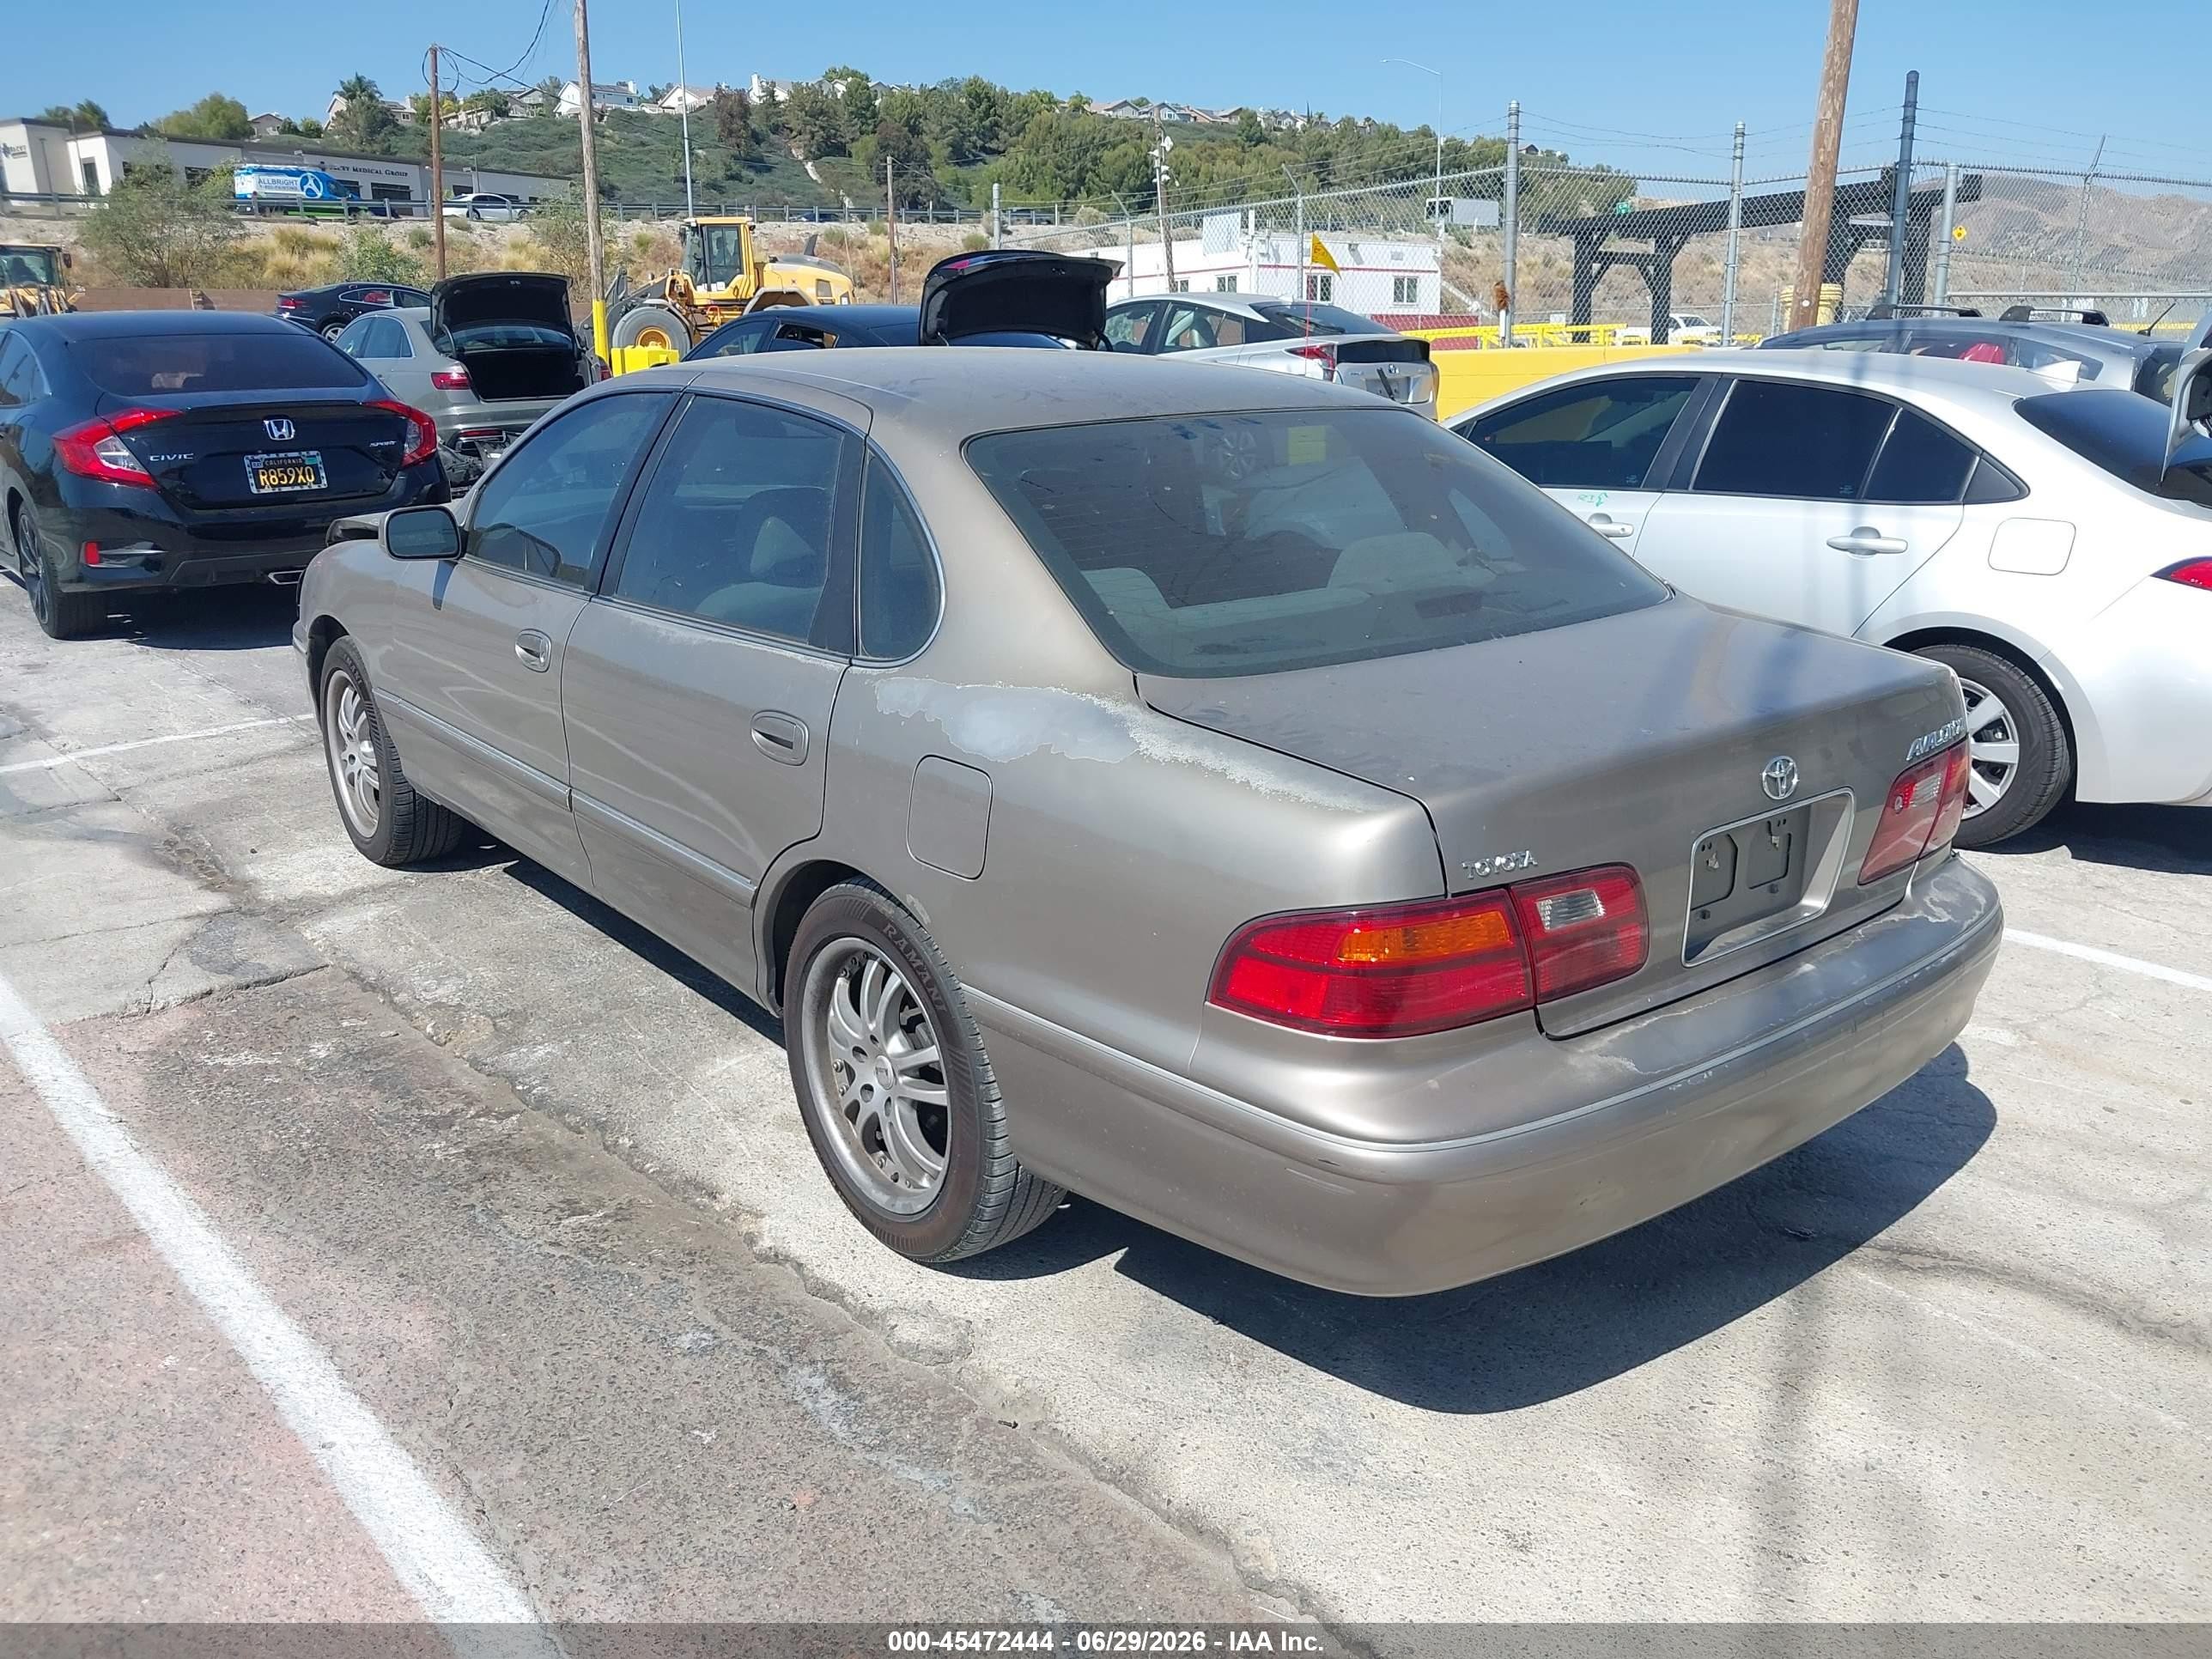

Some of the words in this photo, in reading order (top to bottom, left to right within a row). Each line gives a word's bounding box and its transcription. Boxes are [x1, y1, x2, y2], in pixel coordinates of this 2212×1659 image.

[352, 166, 382, 175] MEDICAL
[149, 453, 194, 462] CIVIC
[264, 458, 303, 466] CALIFORNIA
[1905, 718, 1963, 762] AVALON
[1461, 850, 1538, 879] TOYOTA
